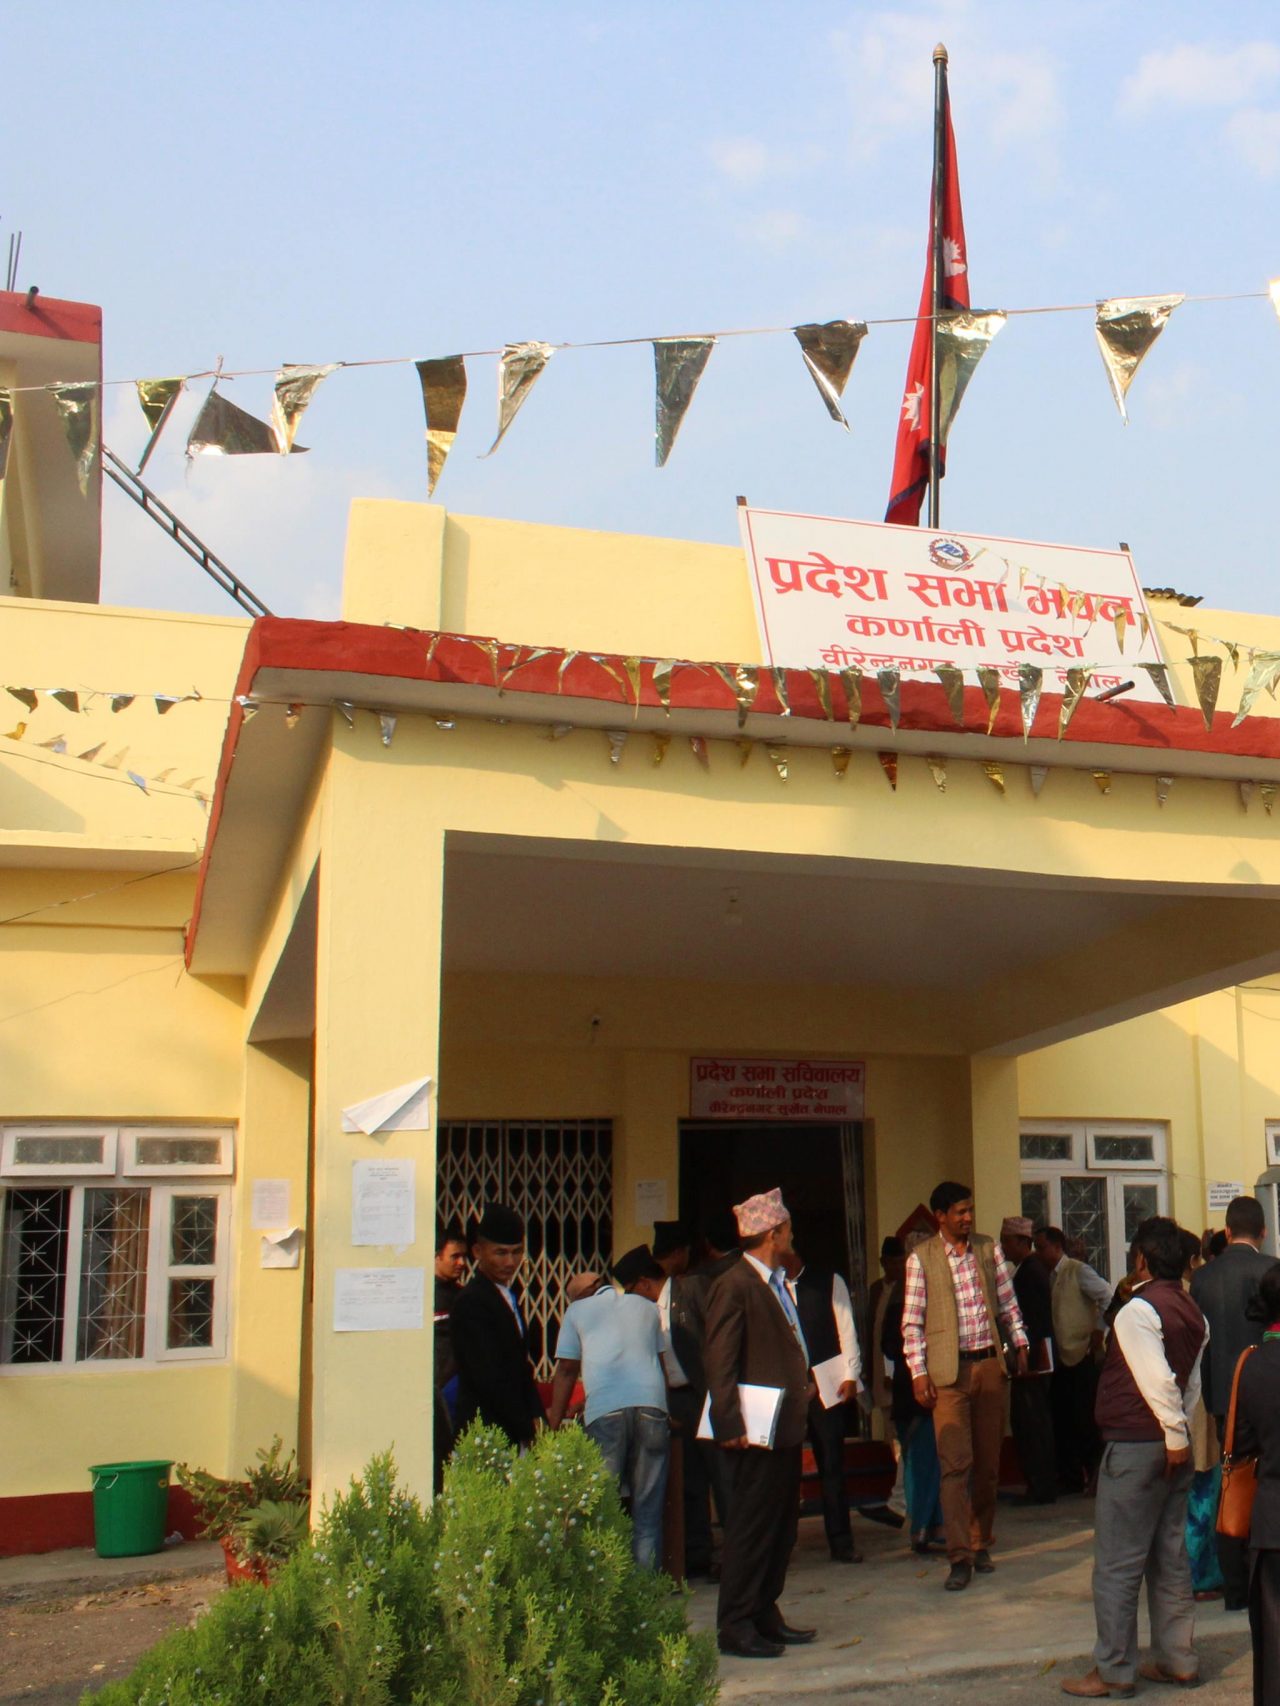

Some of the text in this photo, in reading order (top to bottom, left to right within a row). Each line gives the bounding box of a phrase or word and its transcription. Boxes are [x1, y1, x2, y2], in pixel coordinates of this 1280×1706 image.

[765, 551, 1136, 626] प्रदेश सभा भवन
[845, 614, 1085, 657] कर्णाली प्रदेश
[696, 1061, 861, 1083] प्रदेश सभा सचिवालय
[730, 1085, 829, 1100] कर्णाली प्रदेश
